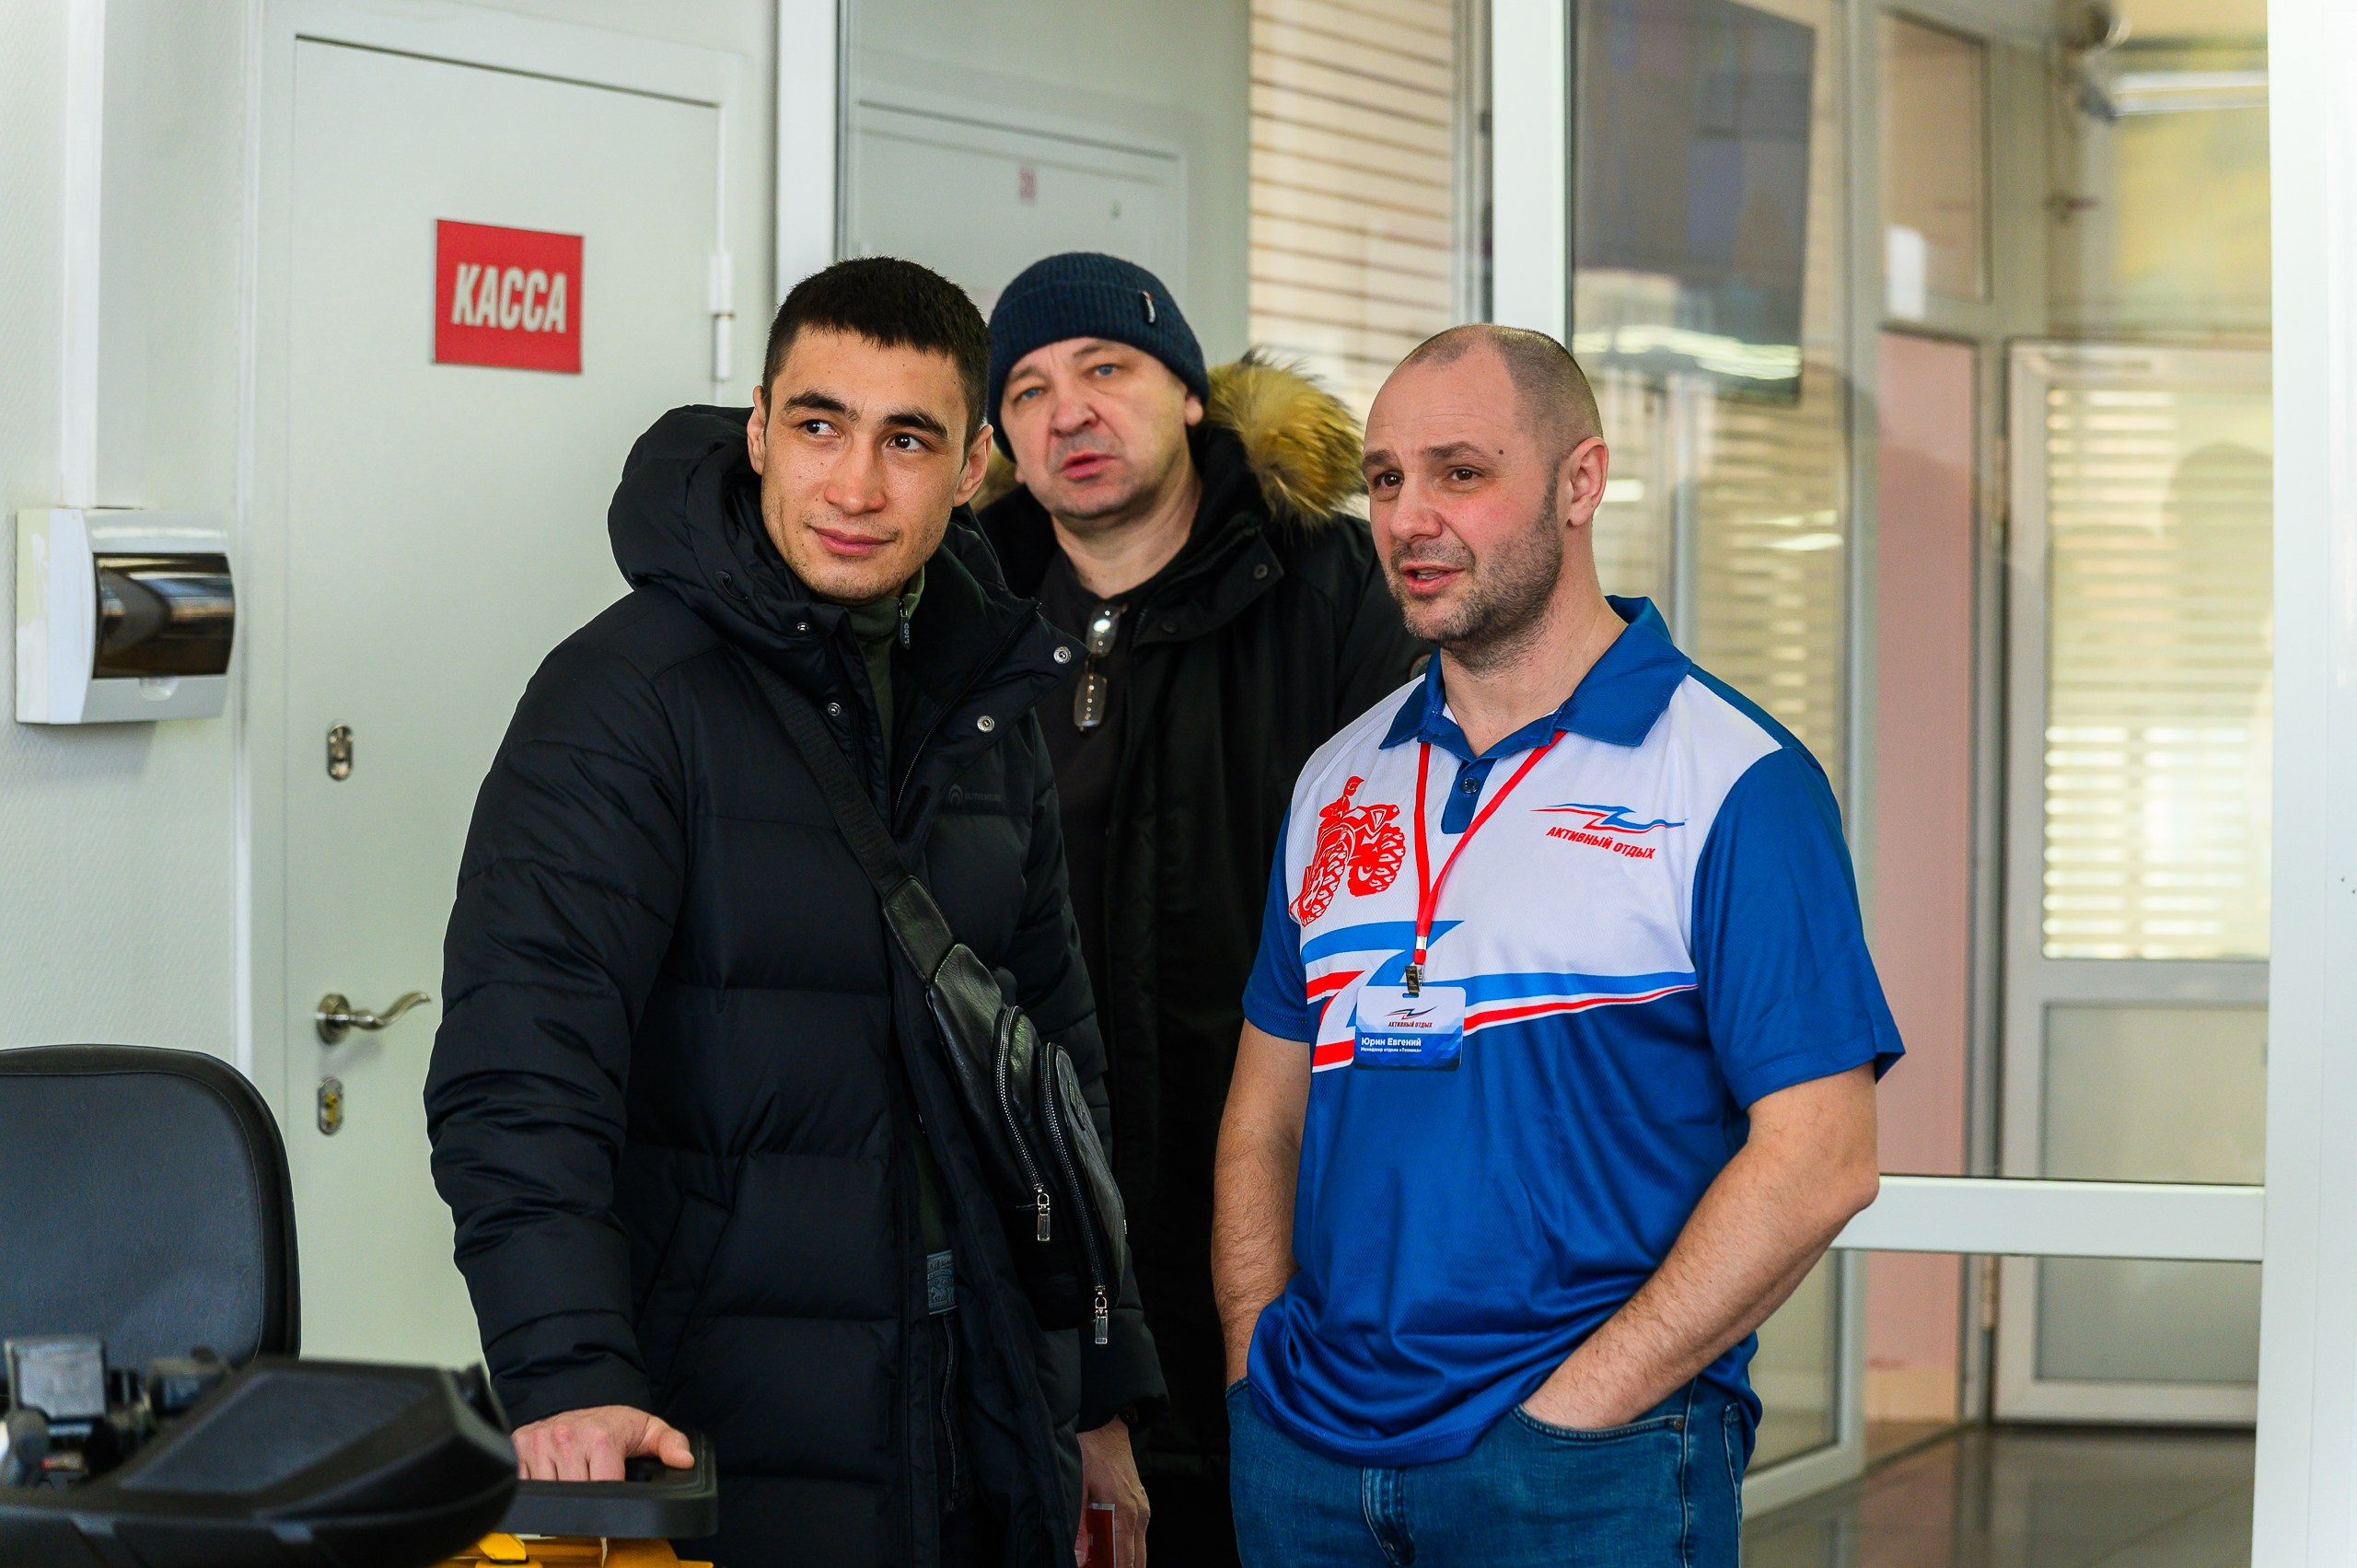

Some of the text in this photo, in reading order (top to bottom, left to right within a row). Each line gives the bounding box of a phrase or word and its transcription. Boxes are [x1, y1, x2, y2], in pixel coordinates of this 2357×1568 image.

[451, 261, 567, 334] КАССА
[1546, 826, 1655, 859] АКТИВНЫЙ ОТДЫХ
[1361, 1037, 1422, 1047] Юрин Евгений
